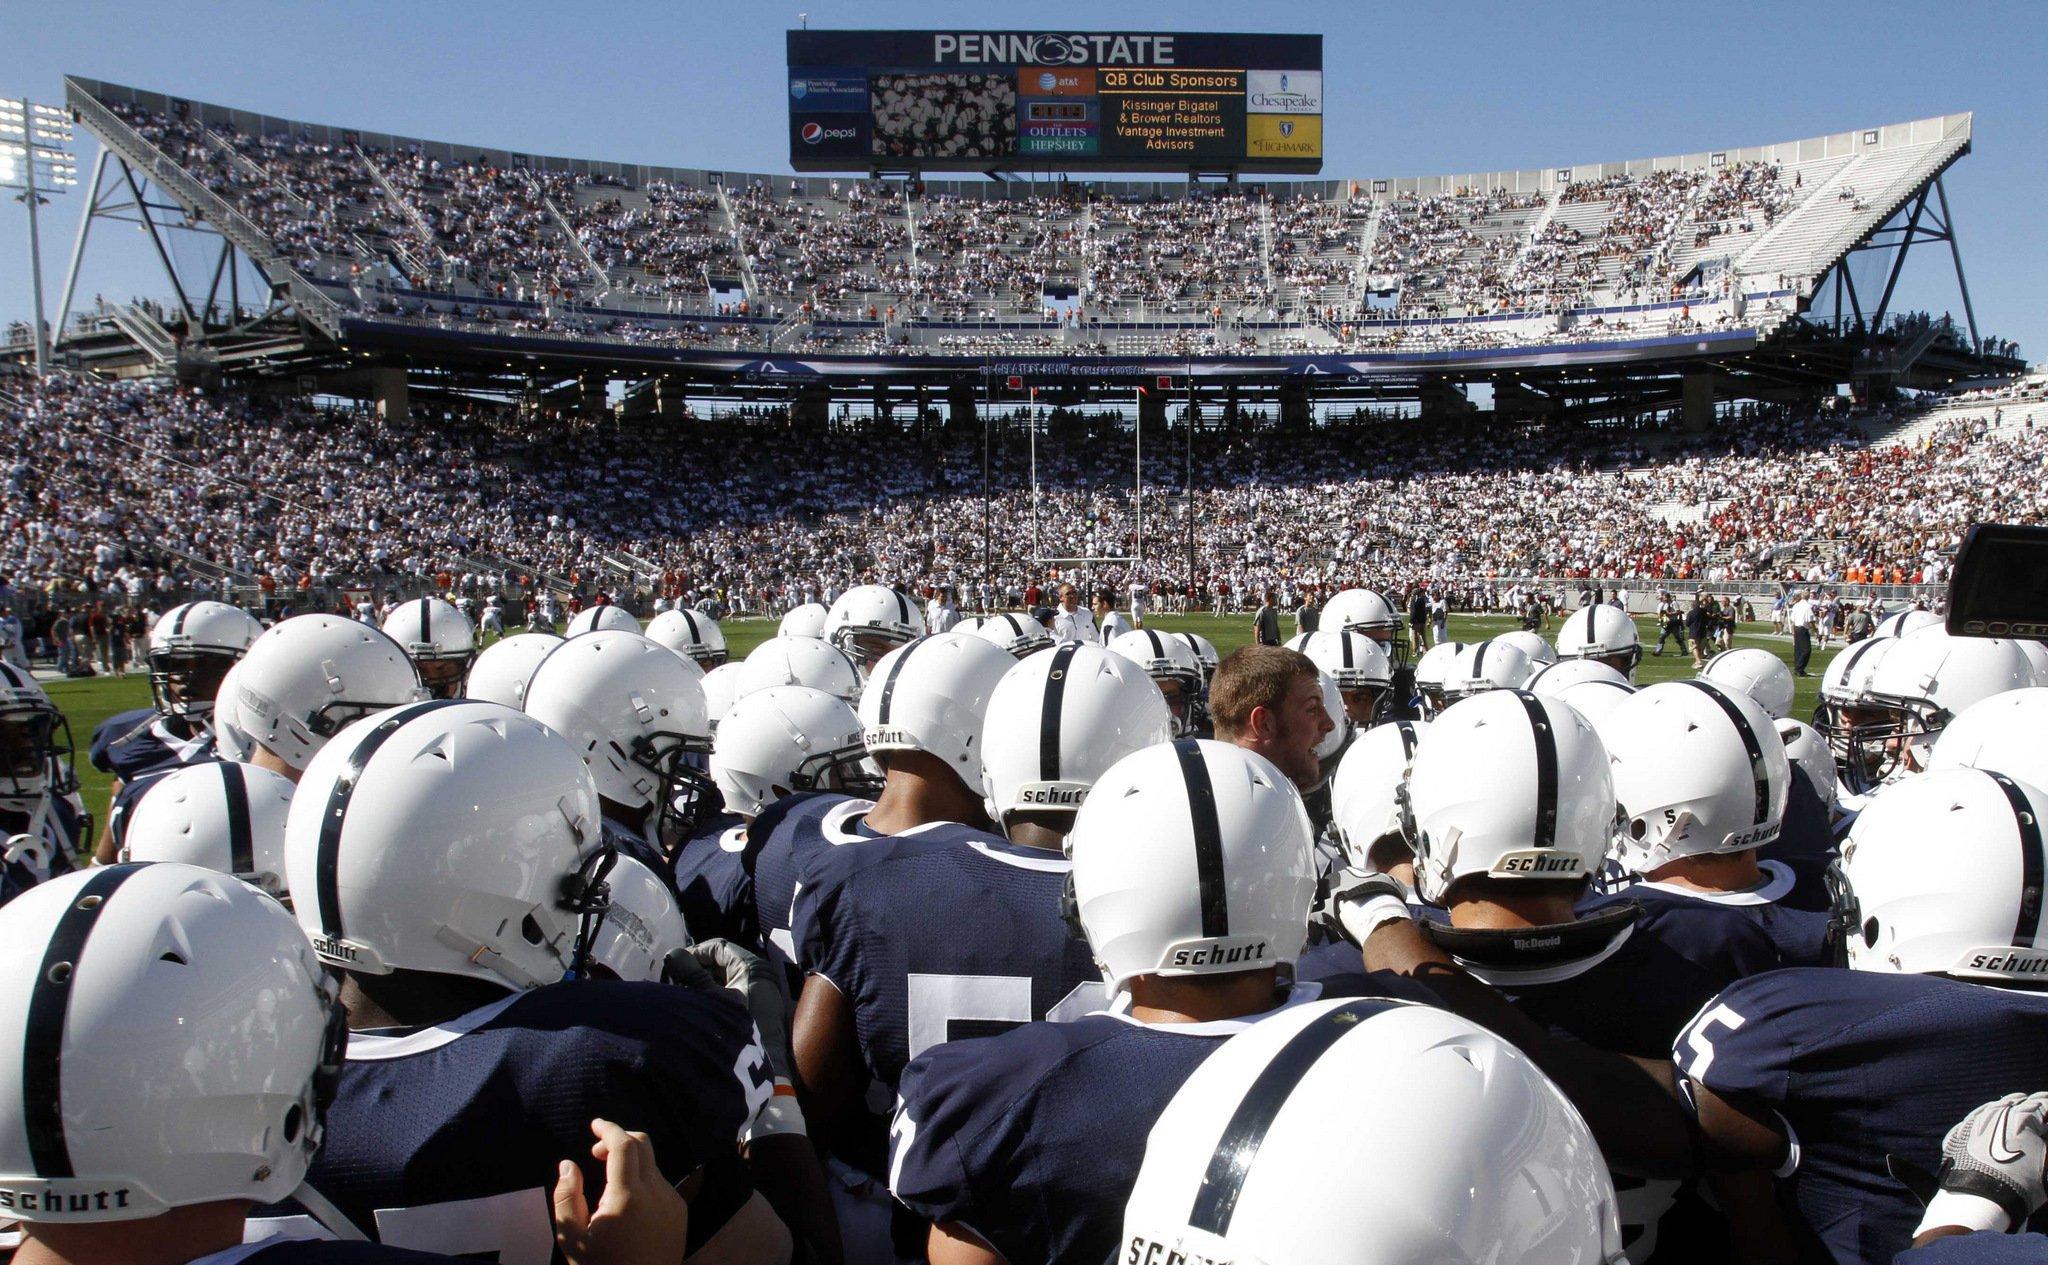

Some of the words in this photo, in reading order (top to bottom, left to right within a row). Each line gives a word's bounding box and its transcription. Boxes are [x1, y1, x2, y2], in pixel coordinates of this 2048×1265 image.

[934, 35, 1033, 63] PENN
[1069, 35, 1175, 64] STATE
[1059, 77, 1079, 86] at&t
[1105, 74, 1128, 86] QB
[1133, 74, 1165, 86] Club
[1170, 74, 1238, 88] Sponsors
[1122, 100, 1175, 113] Kissinger
[1178, 100, 1218, 113] Bigatel
[1251, 93, 1317, 111] Chesapeake
[1120, 113, 1128, 123] &
[1132, 113, 1172, 124] Brower
[1174, 113, 1221, 124] Realtors
[824, 128, 856, 139] pepsi
[1030, 127, 1087, 137] OUTLETS
[1116, 126, 1163, 138] Vantage
[1166, 126, 1225, 137] Investment
[1031, 140, 1086, 150] HERSHEY
[1146, 139, 1195, 150] Advisors
[1253, 140, 1314, 153] HIGHMARK
[866, 729, 904, 745] schutt
[1505, 854, 1580, 872] schutt
[314, 938, 358, 961] schutt
[1513, 935, 1561, 951] McDavid
[1174, 941, 1266, 966] schutt
[0, 1188, 130, 1213] schutt
